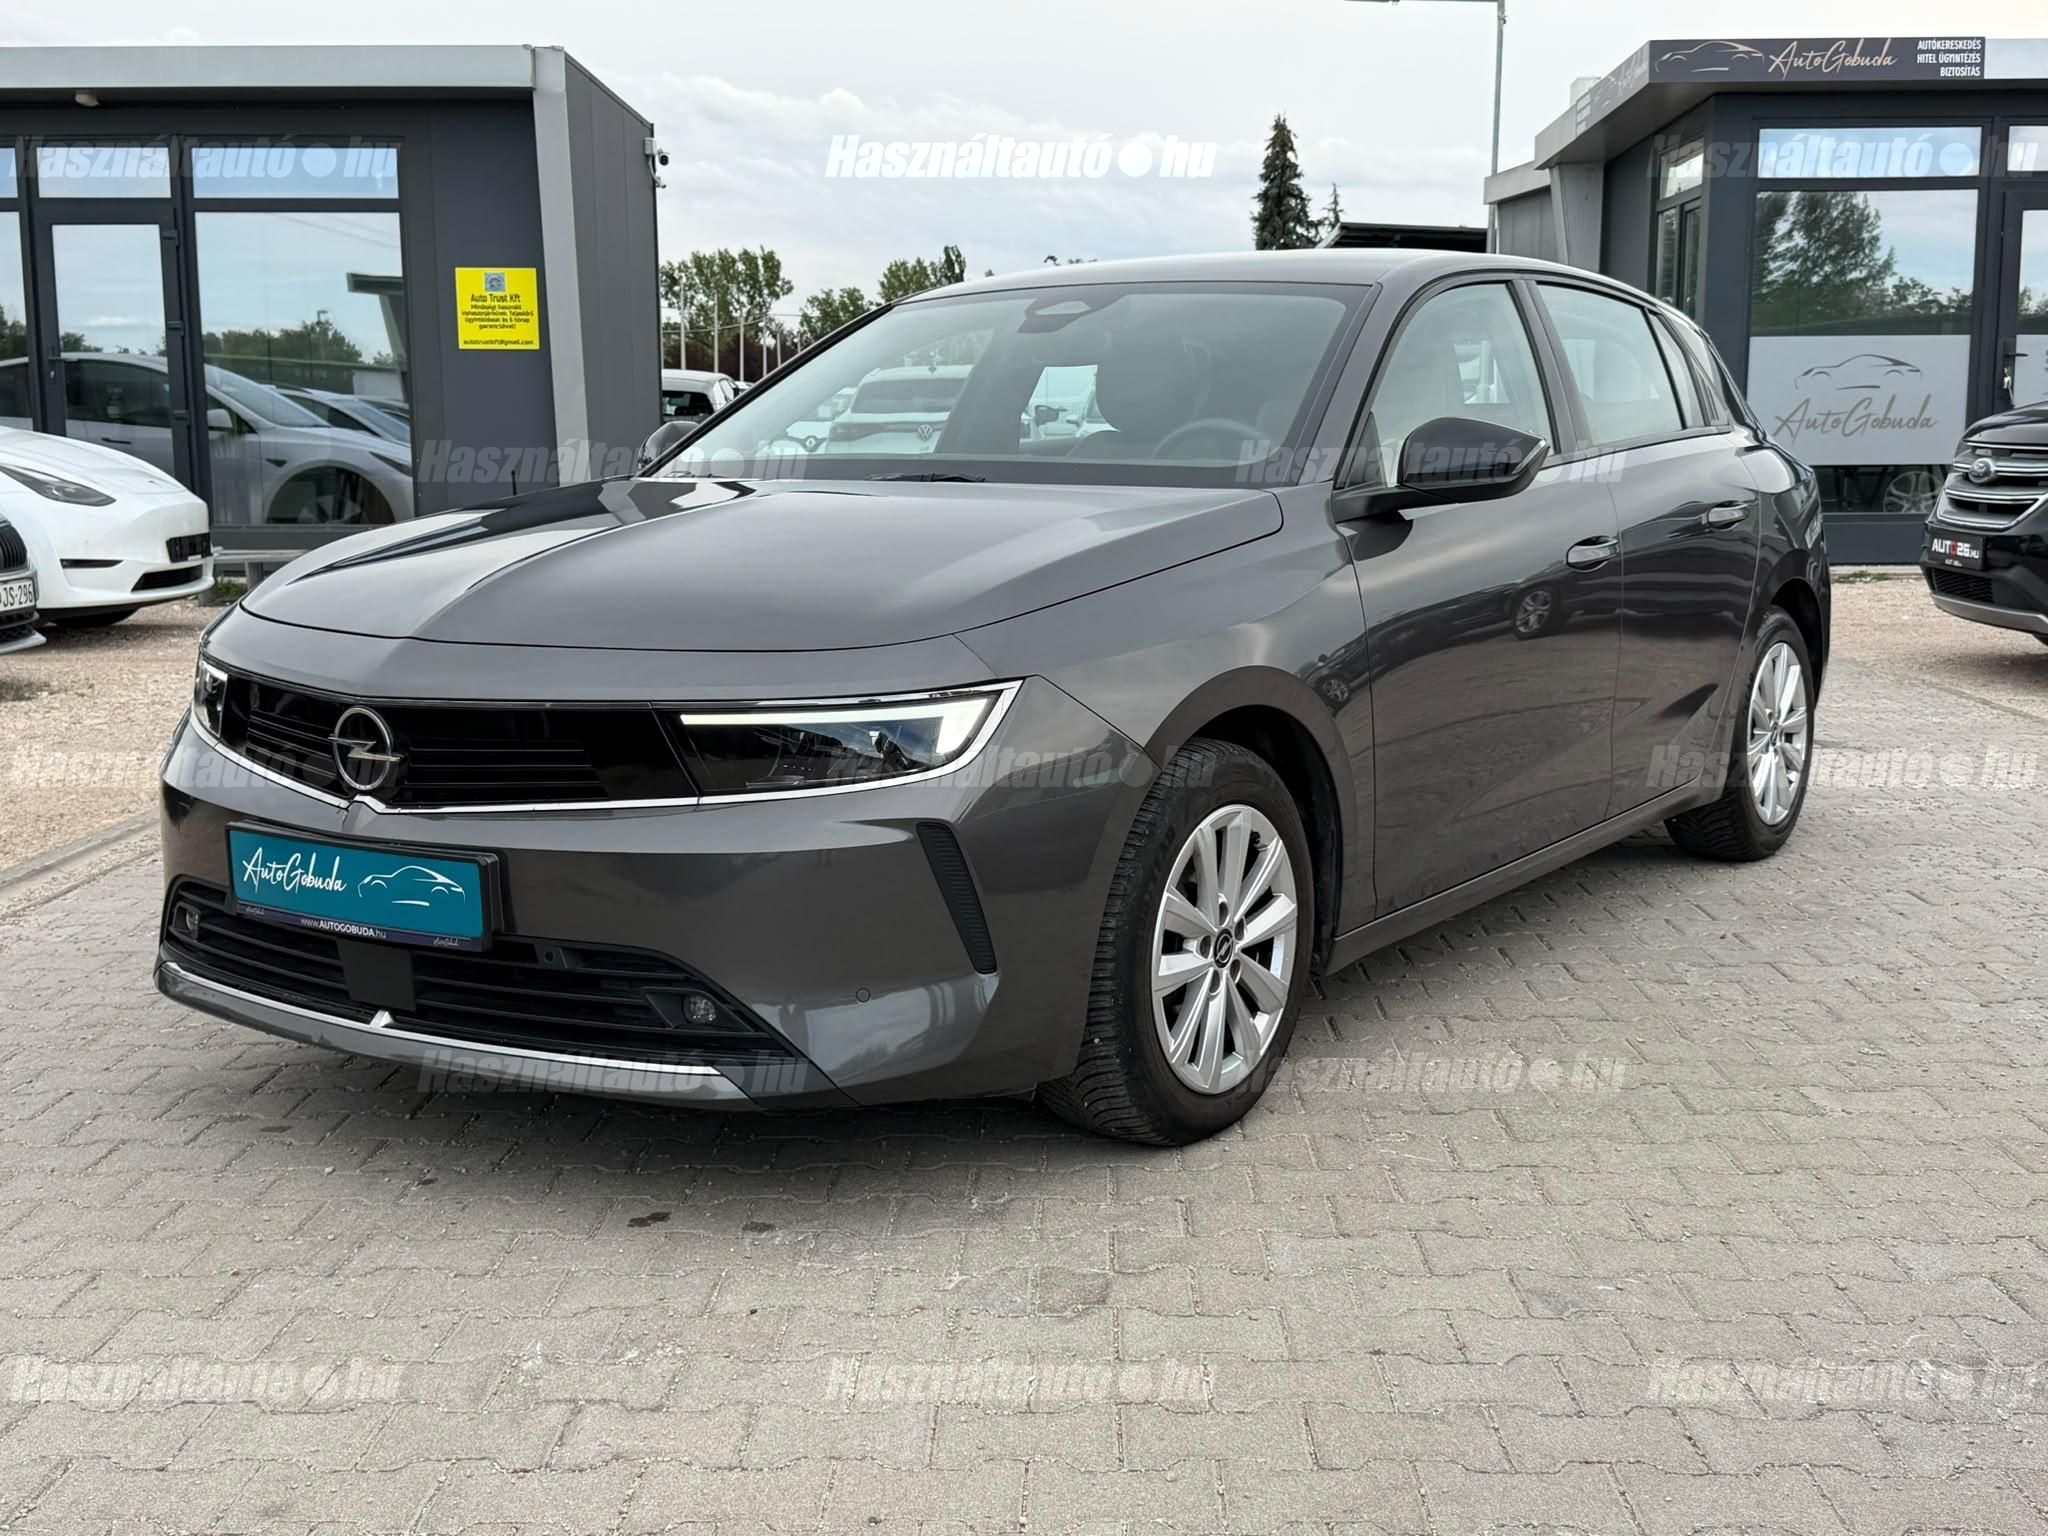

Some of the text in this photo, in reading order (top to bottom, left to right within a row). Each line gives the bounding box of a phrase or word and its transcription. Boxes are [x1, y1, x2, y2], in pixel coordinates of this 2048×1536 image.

[1917, 38, 1982, 50] AUTÓKERESKEDÉS
[1768, 38, 1898, 80] AutoGobuda
[1917, 51, 1981, 64] HITEL ÜGYINTÉZÉS
[1940, 65, 1981, 77] BIZTOSÍTÁS
[471, 294, 521, 303] Auto Trust Kft
[1772, 393, 1938, 447] AutoGobuda
[0, 584, 33, 608] JS-296
[242, 847, 347, 894] AutoGobuda
[300, 918, 387, 940] www.AUTOGOBUDA.hu
